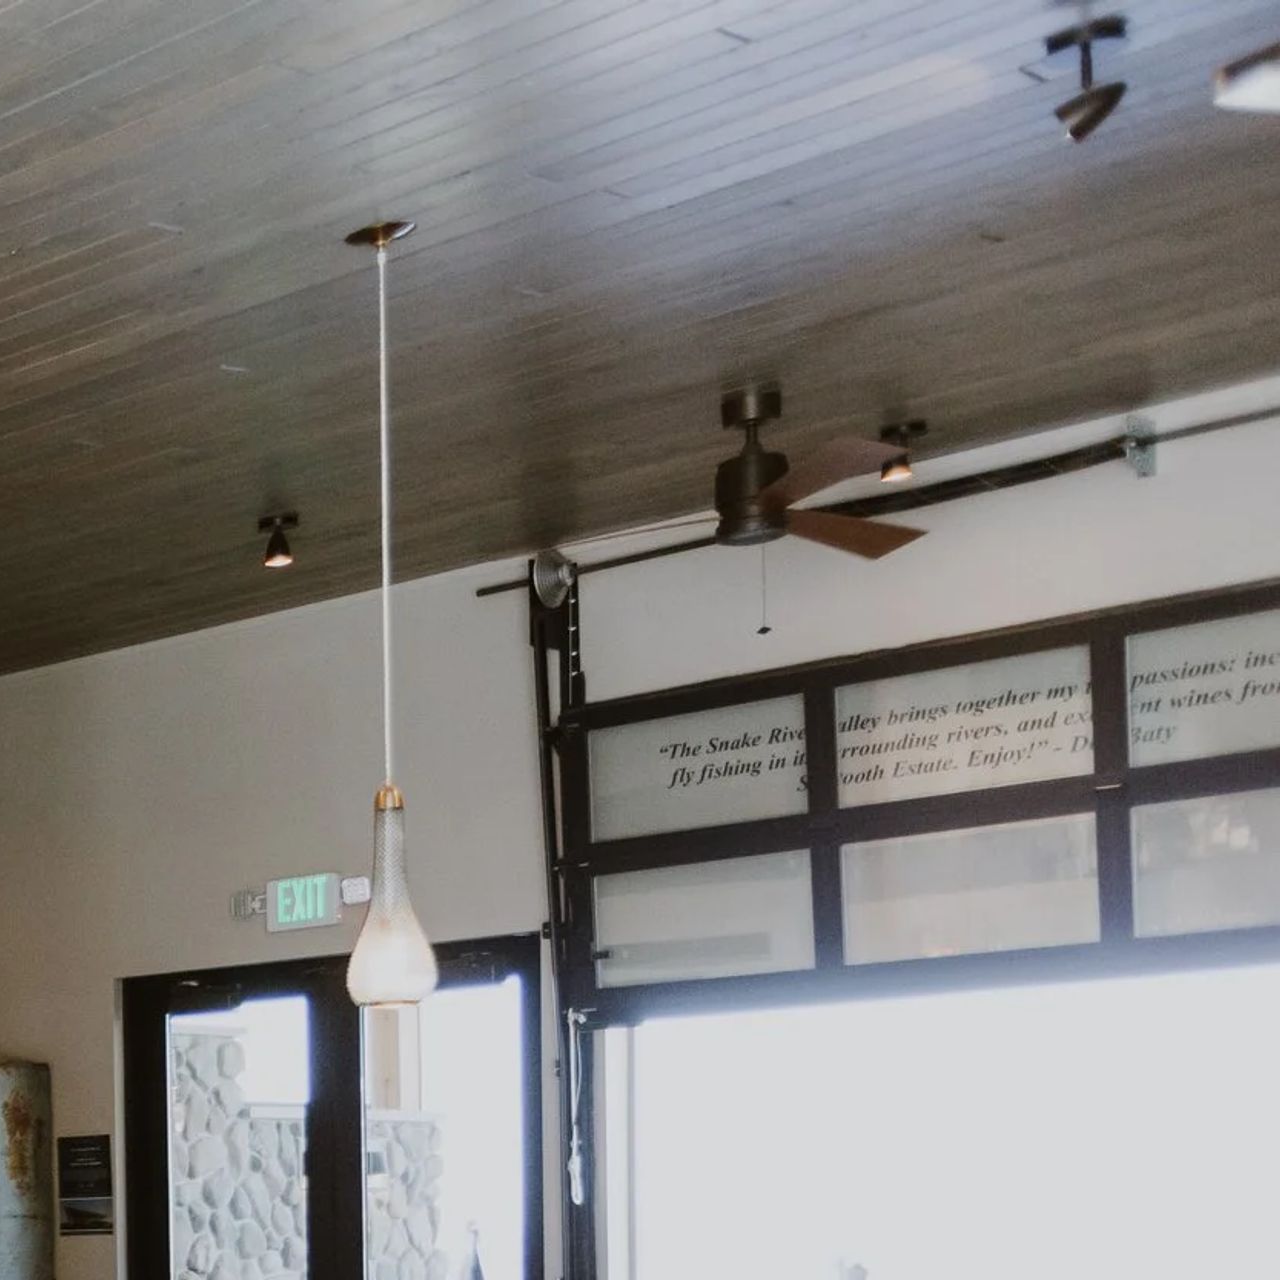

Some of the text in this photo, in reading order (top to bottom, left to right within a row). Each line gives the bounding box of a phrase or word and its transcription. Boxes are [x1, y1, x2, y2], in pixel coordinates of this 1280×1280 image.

[667, 767, 696, 789] fly
[697, 759, 762, 785] fishing
[768, 754, 786, 771] in
[792, 750, 808, 768] it
[840, 733, 940, 760] rrounding
[1017, 711, 1058, 733] and
[1170, 688, 1232, 708] wines
[706, 732, 762, 755] Snake
[768, 725, 807, 746] Rive
[837, 713, 881, 734] alley
[887, 704, 949, 725] brings
[955, 690, 1040, 717] together
[1046, 682, 1079, 701] my
[277, 873, 327, 923] EXIT
